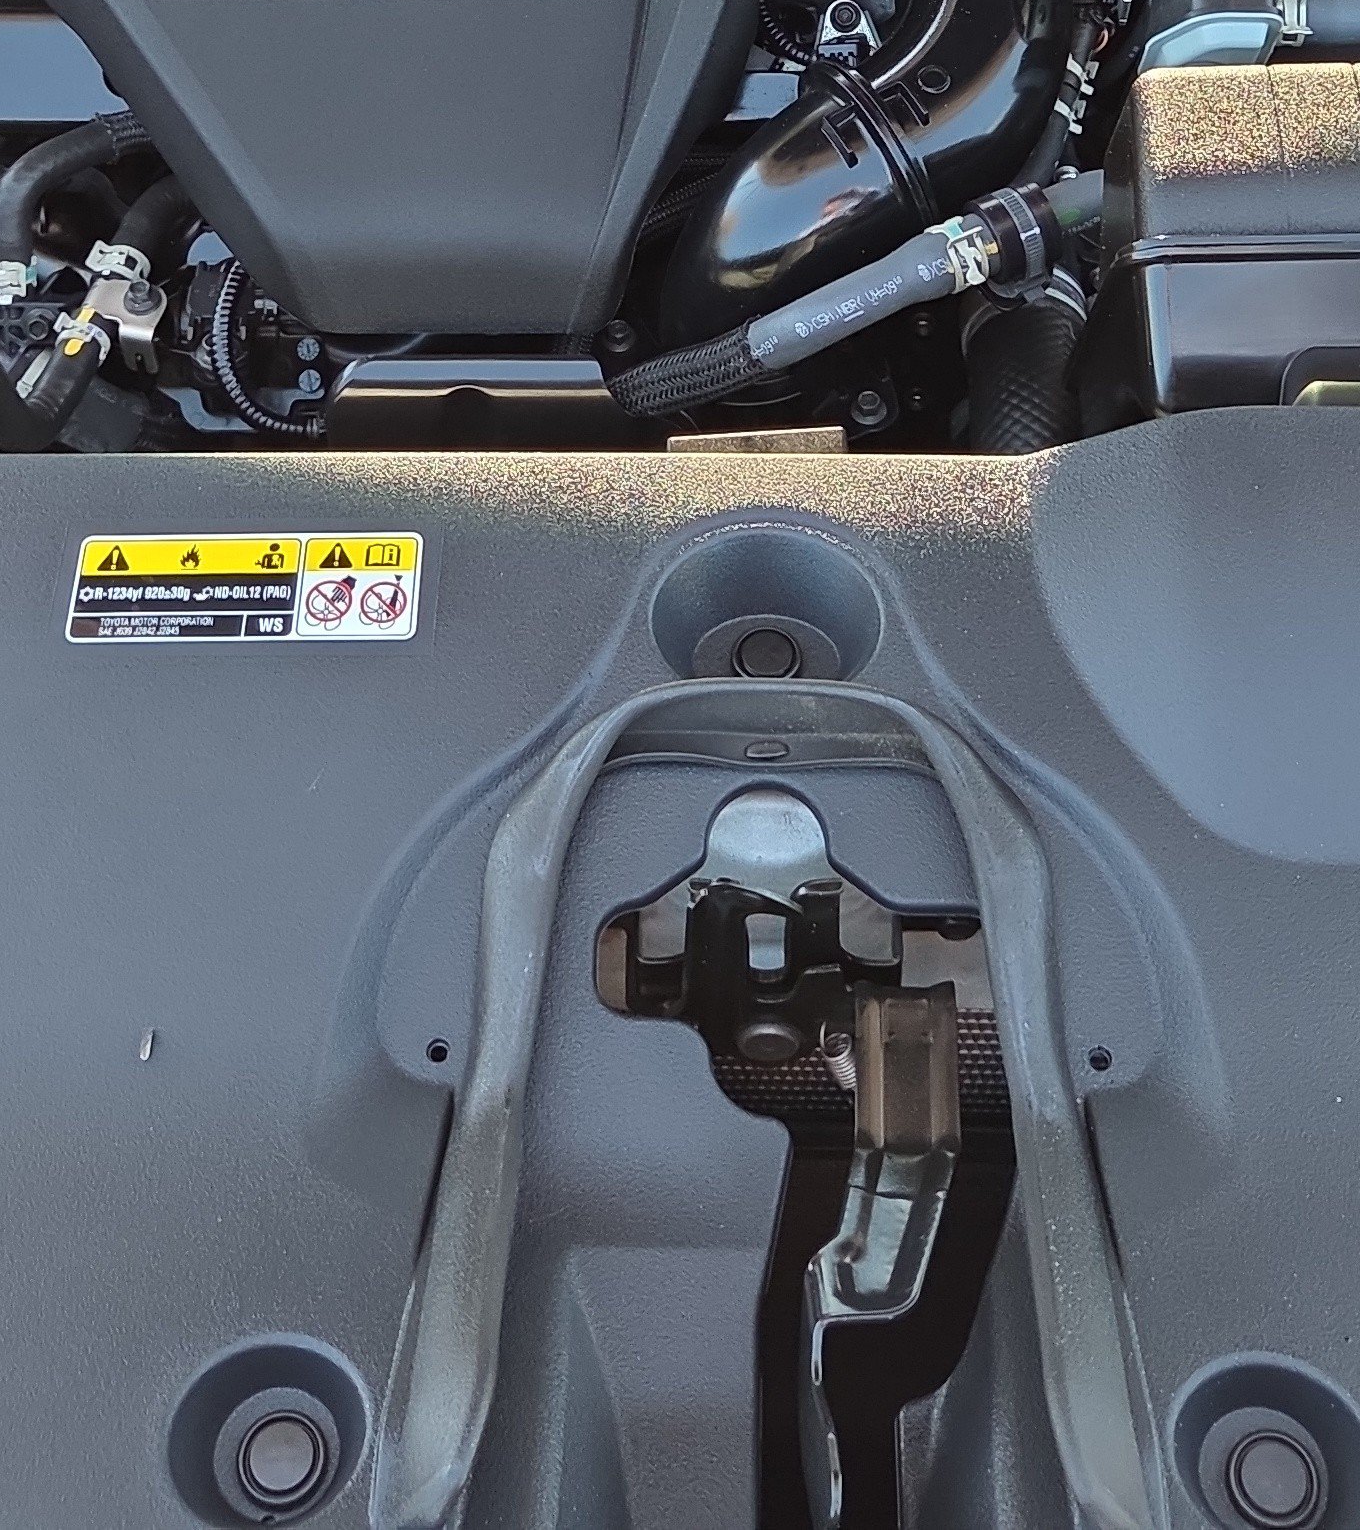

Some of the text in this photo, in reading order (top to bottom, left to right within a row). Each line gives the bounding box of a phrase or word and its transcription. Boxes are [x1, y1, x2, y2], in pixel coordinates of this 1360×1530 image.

[94, 586, 143, 602] R-1234yf
[213, 585, 262, 600] ND-OIL12
[262, 585, 292, 601] (PAG)
[99, 617, 214, 627] TOYOTA MOTOR CORPORATION
[258, 617, 284, 633] WS
[97, 626, 113, 636] SAE
